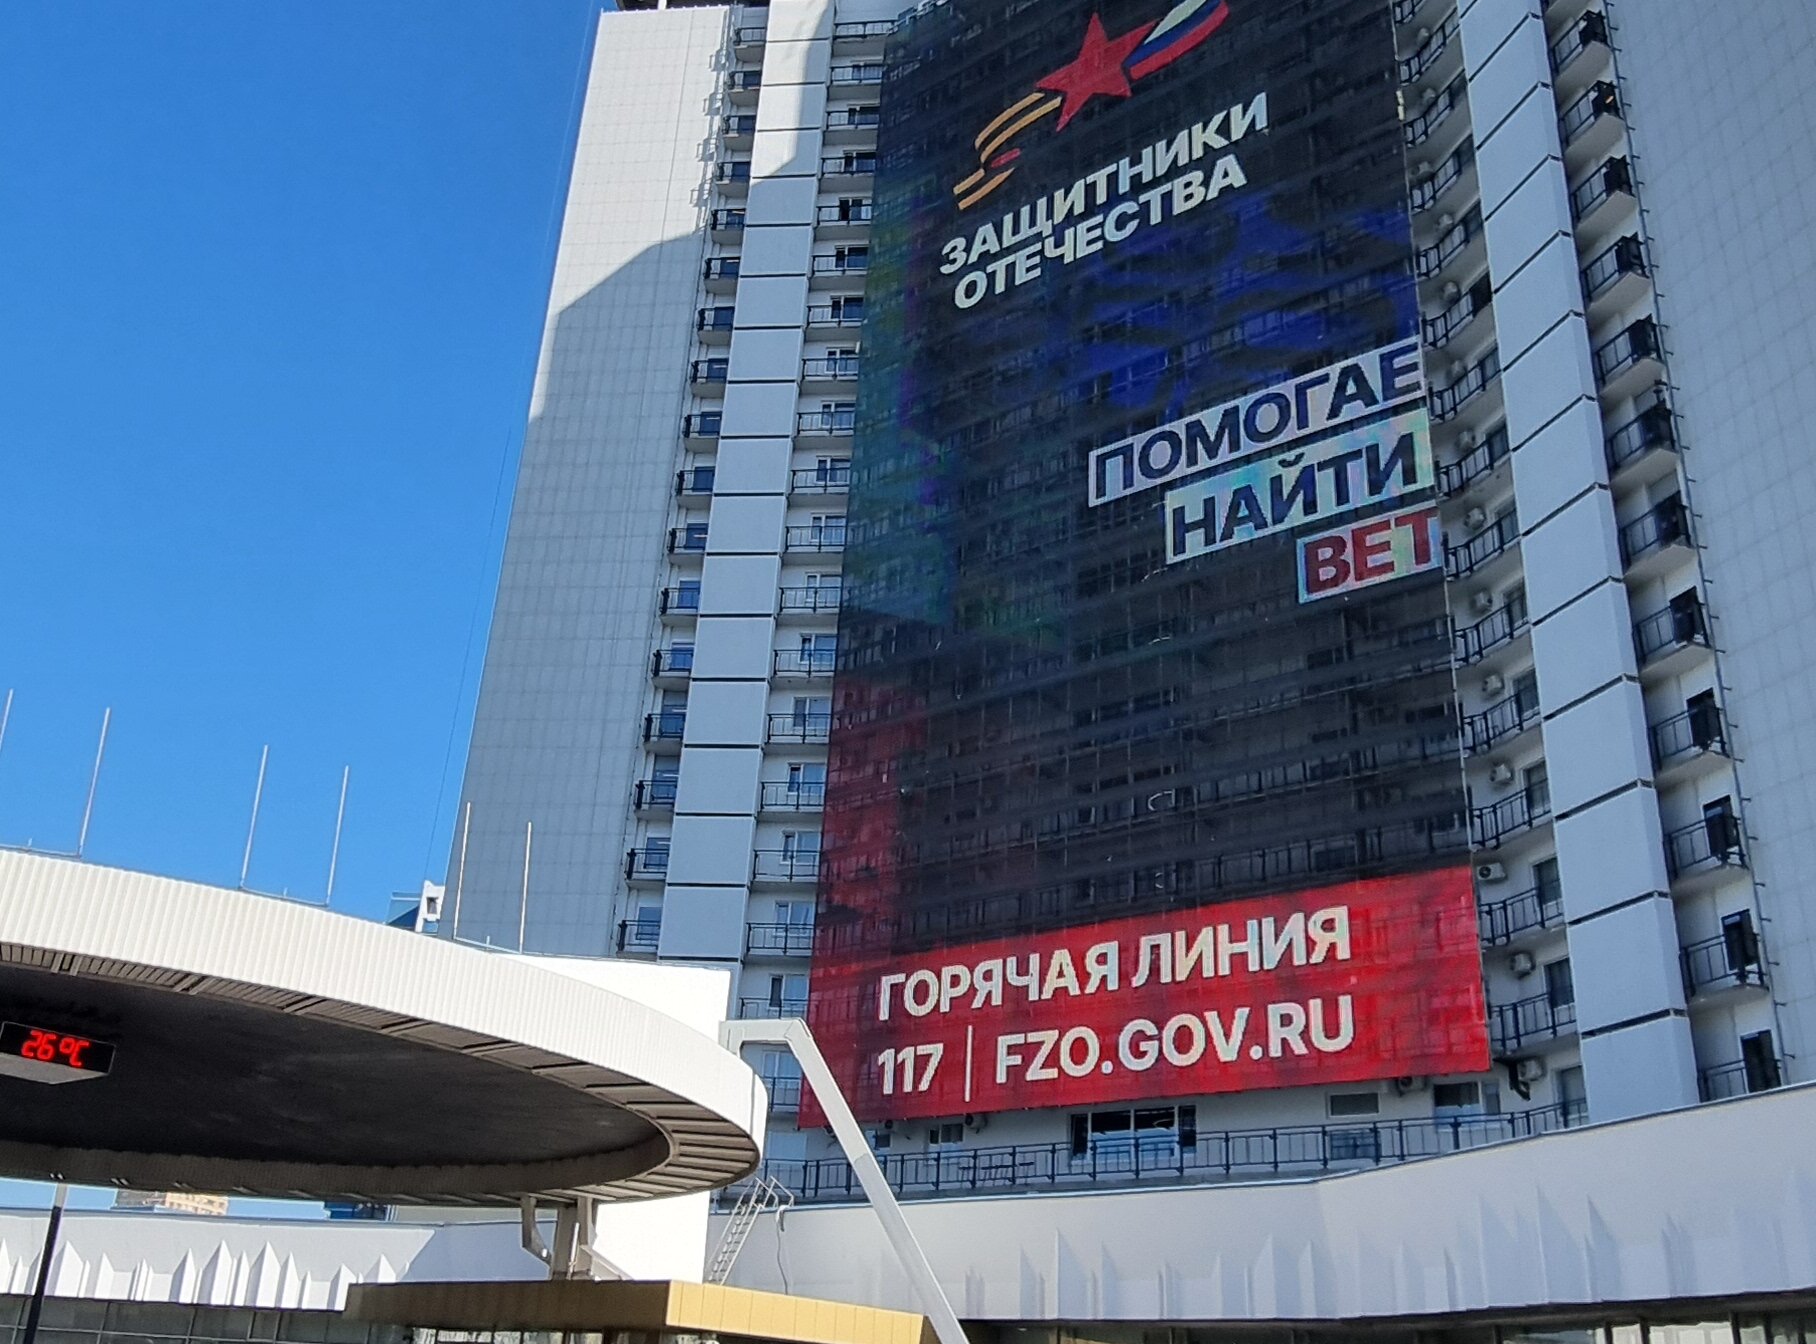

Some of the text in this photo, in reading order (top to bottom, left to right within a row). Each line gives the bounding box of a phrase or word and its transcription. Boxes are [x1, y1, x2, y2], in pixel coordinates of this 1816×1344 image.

[939, 92, 1269, 275] ЗАЩИТНИКИ
[953, 154, 1247, 309] ОТЕЧЕСТВА
[1095, 343, 1422, 500] ПОМОГАЕ
[1172, 432, 1418, 556] НАЙТИ
[1303, 506, 1438, 595] ВЕТ
[879, 906, 1351, 1021] ГОРЯЧАЯ ЛИНИЯ
[878, 995, 1355, 1095] 117 FZO.GOV.RU
